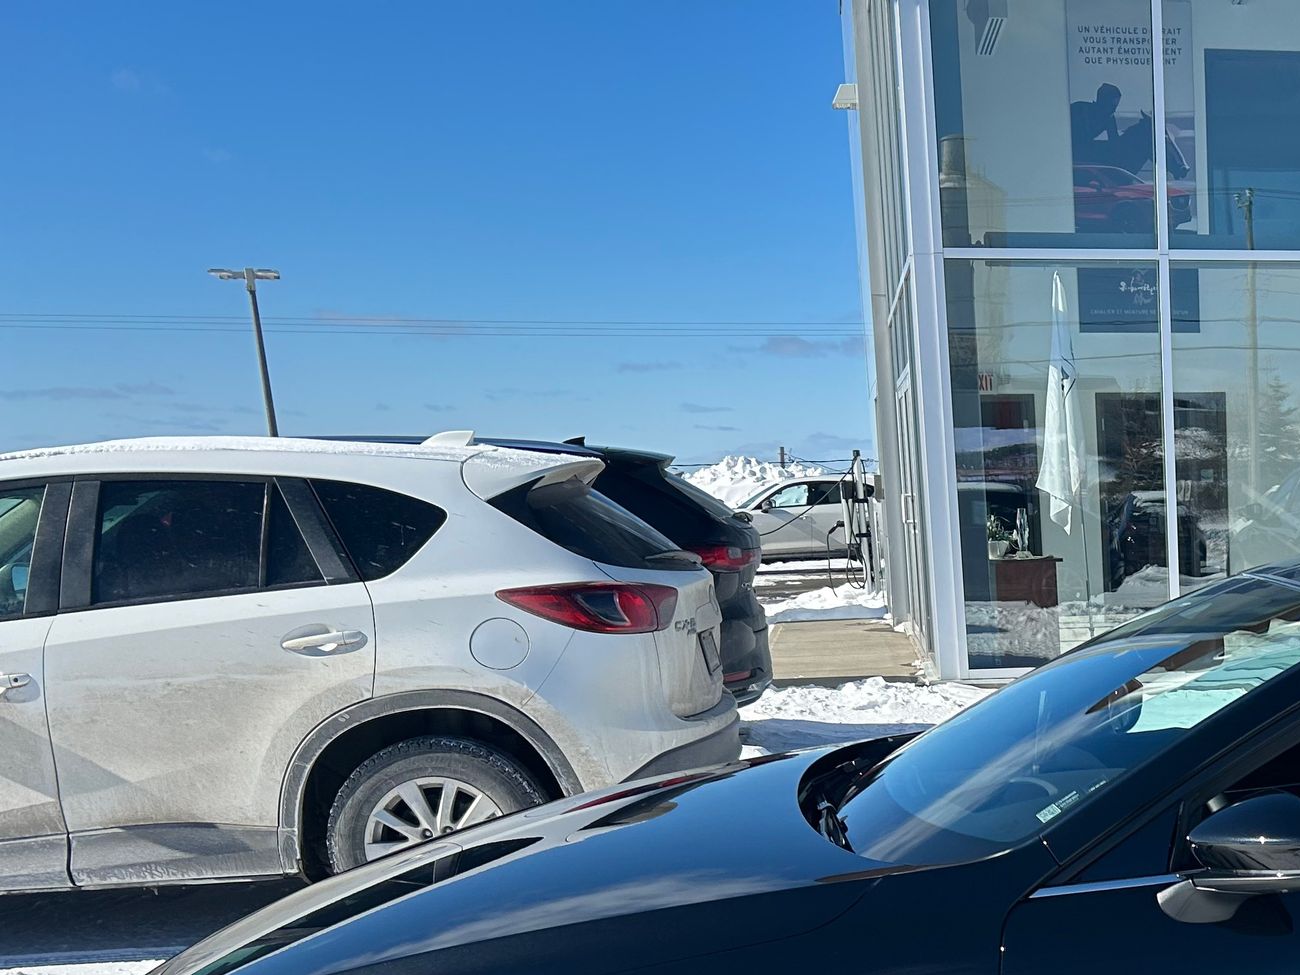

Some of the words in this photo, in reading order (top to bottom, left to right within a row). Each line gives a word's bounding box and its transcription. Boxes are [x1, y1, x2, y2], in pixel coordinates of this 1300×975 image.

[1077, 25, 1090, 34] UN
[1093, 26, 1139, 35] VÉHICULE
[1083, 36, 1108, 45] VOUS
[1078, 46, 1114, 55] AUTANT
[1084, 56, 1103, 65] QUE
